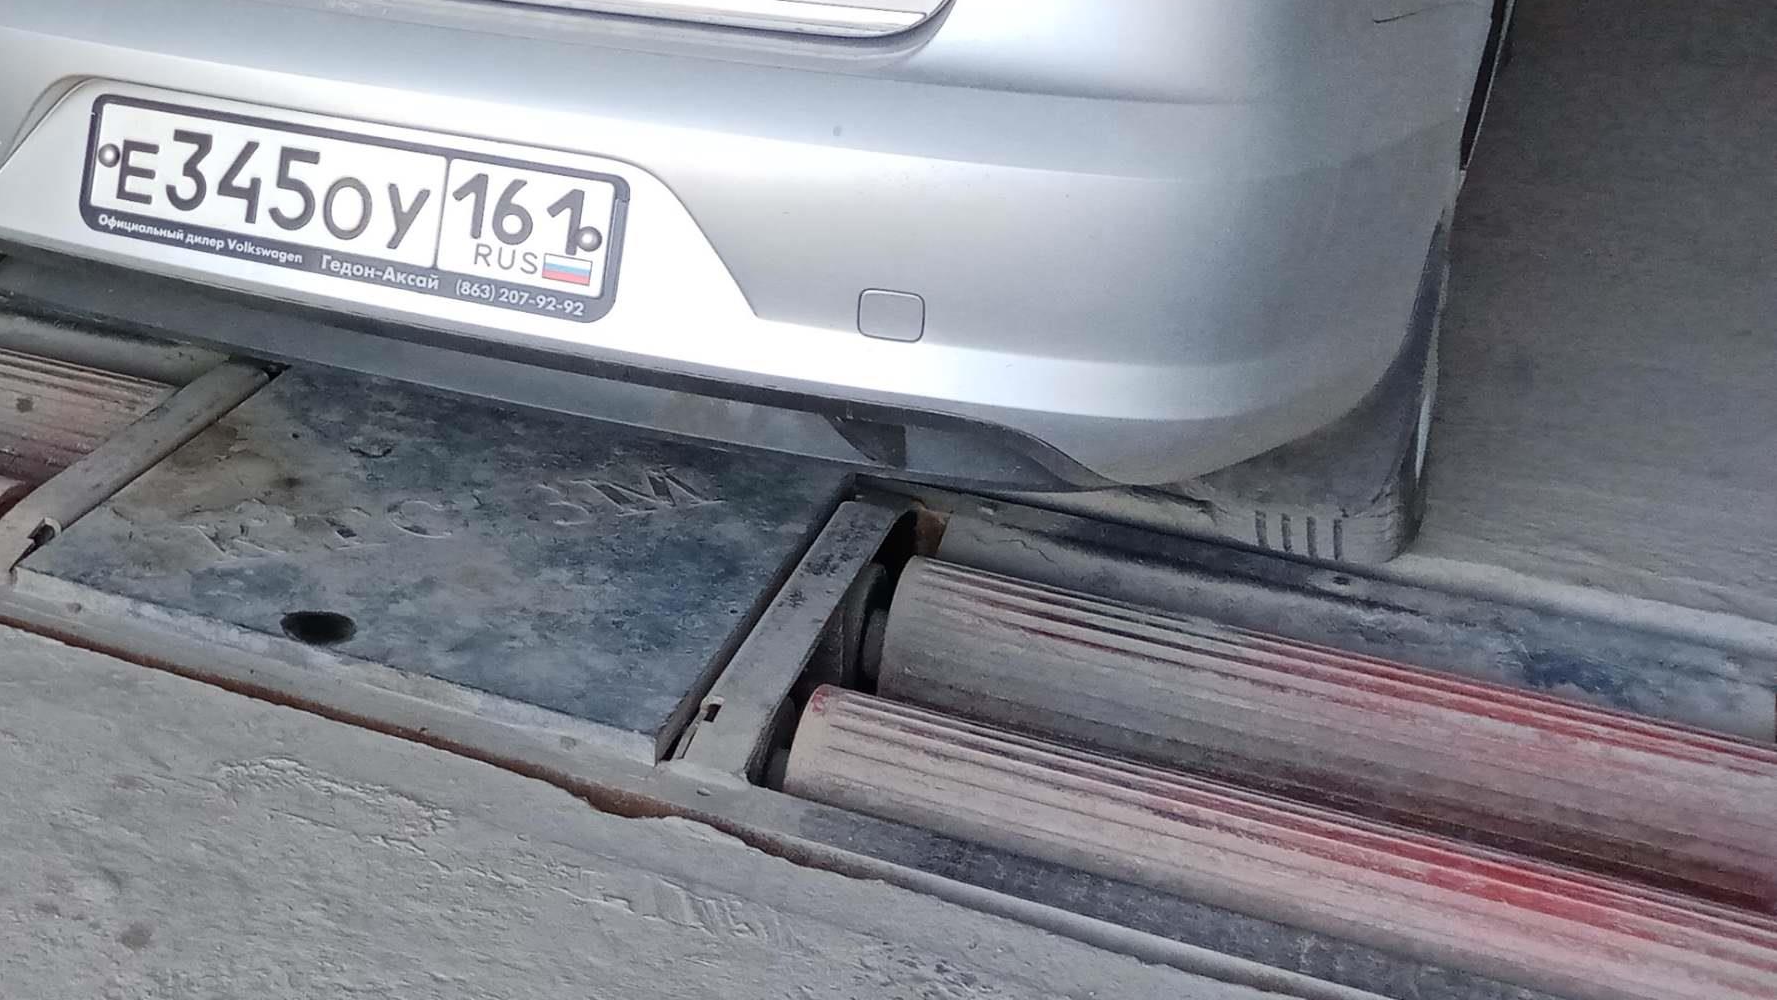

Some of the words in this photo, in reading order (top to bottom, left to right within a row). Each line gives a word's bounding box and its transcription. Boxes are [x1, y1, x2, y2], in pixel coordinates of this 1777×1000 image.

[115, 128, 431, 250] Е345ОУ
[452, 172, 589, 256] 161
[98, 213, 185, 242] Официальный
[185, 232, 225, 250] дилер
[227, 238, 303, 264] Volkswagen
[320, 254, 440, 290] Гедон-Аксай
[455, 278, 497, 302] (863)
[499, 287, 585, 317] 207-92-92
[473, 243, 539, 276] RUS
